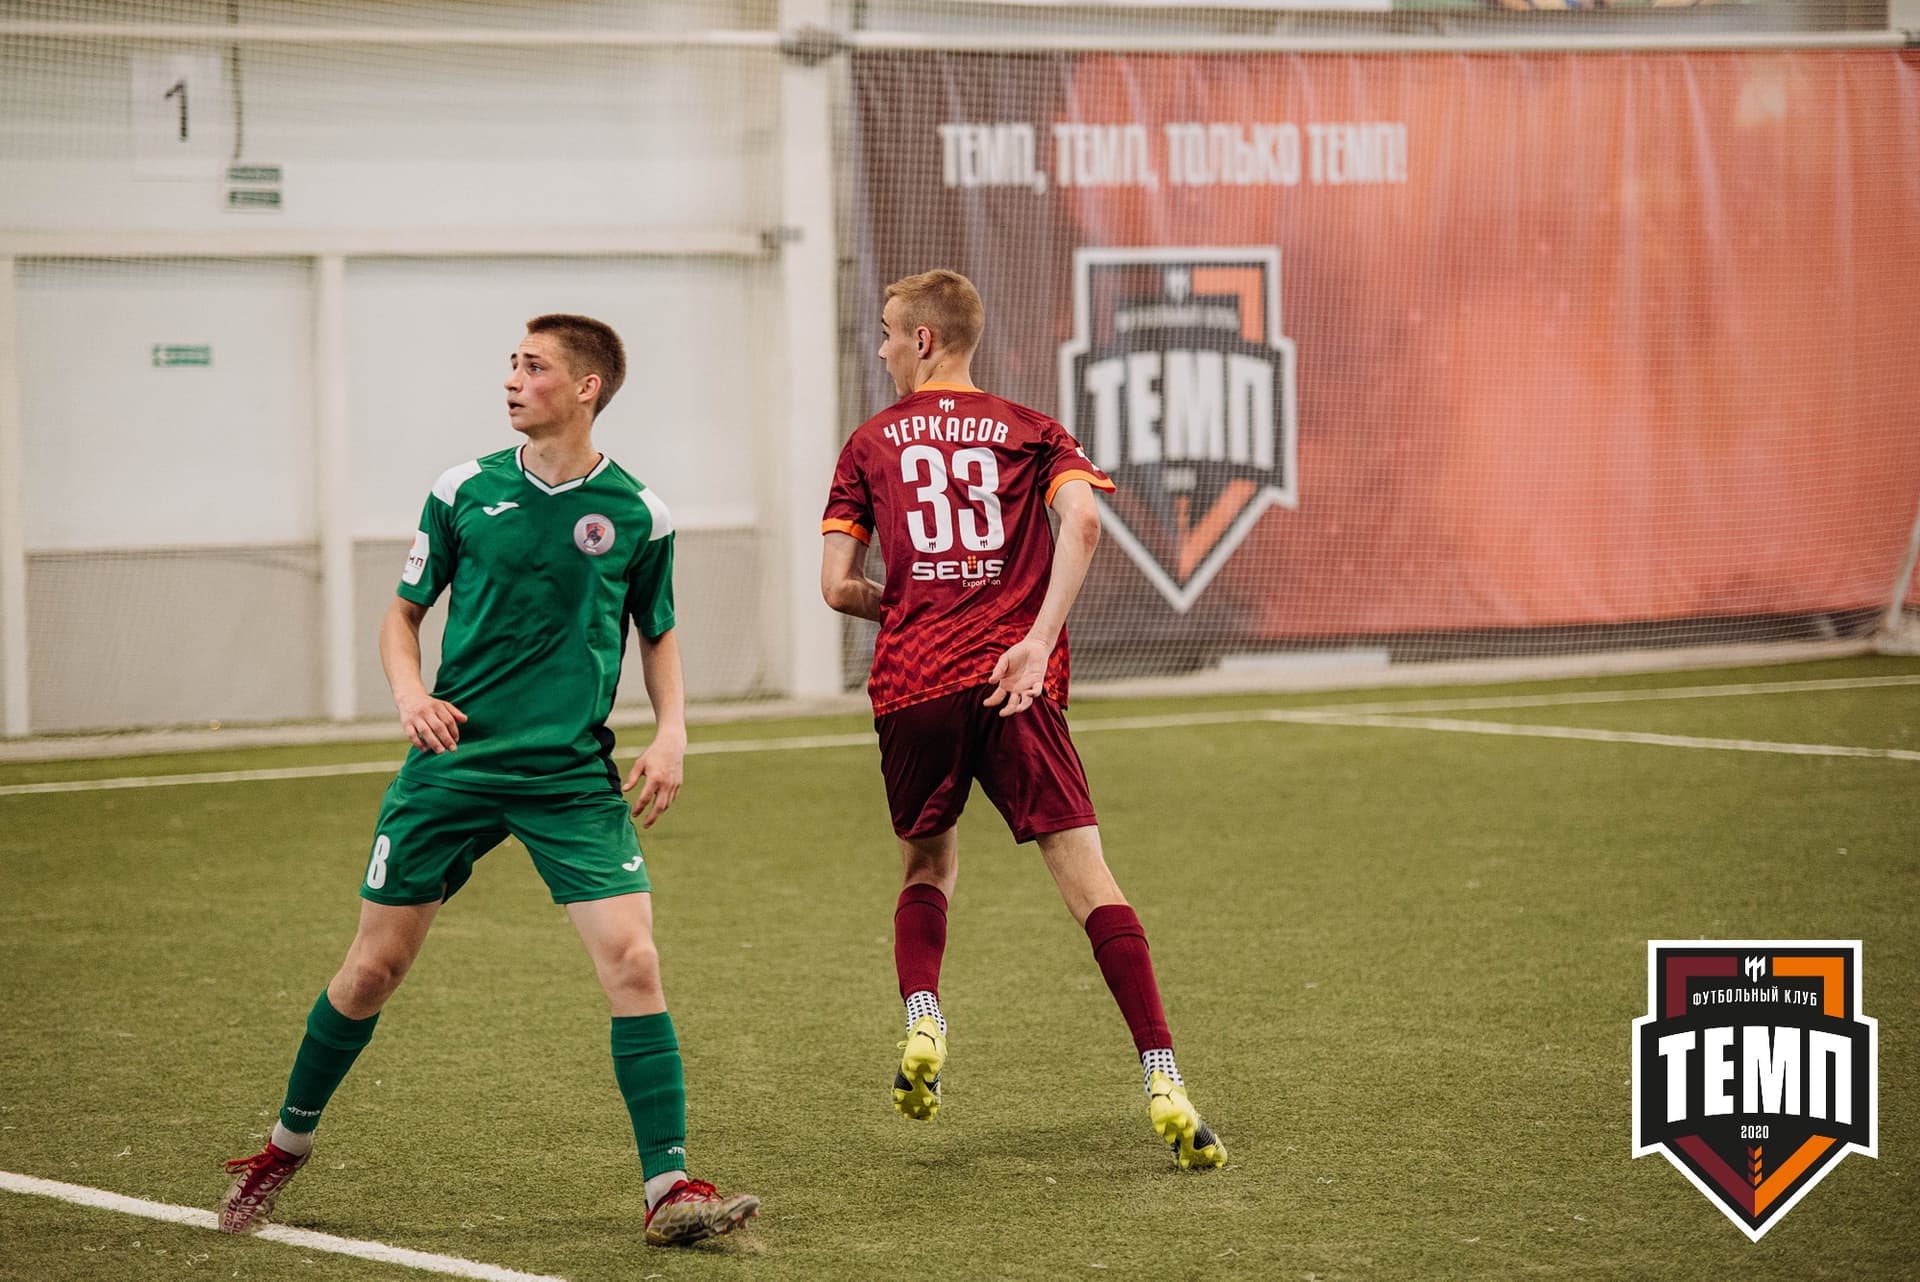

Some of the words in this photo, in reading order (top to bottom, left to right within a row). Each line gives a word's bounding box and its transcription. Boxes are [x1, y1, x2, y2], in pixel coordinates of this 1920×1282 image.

[164, 78, 189, 142] 1
[937, 123, 1047, 195] ТЕМП,
[1054, 123, 1159, 193] ТЕМП,
[1164, 123, 1299, 185] ТОЛЬКО
[883, 415, 1009, 447] ЧЕРКАСОВ
[1085, 350, 1275, 472] ТЕМП
[900, 445, 1005, 554] 33
[366, 834, 392, 890] 8
